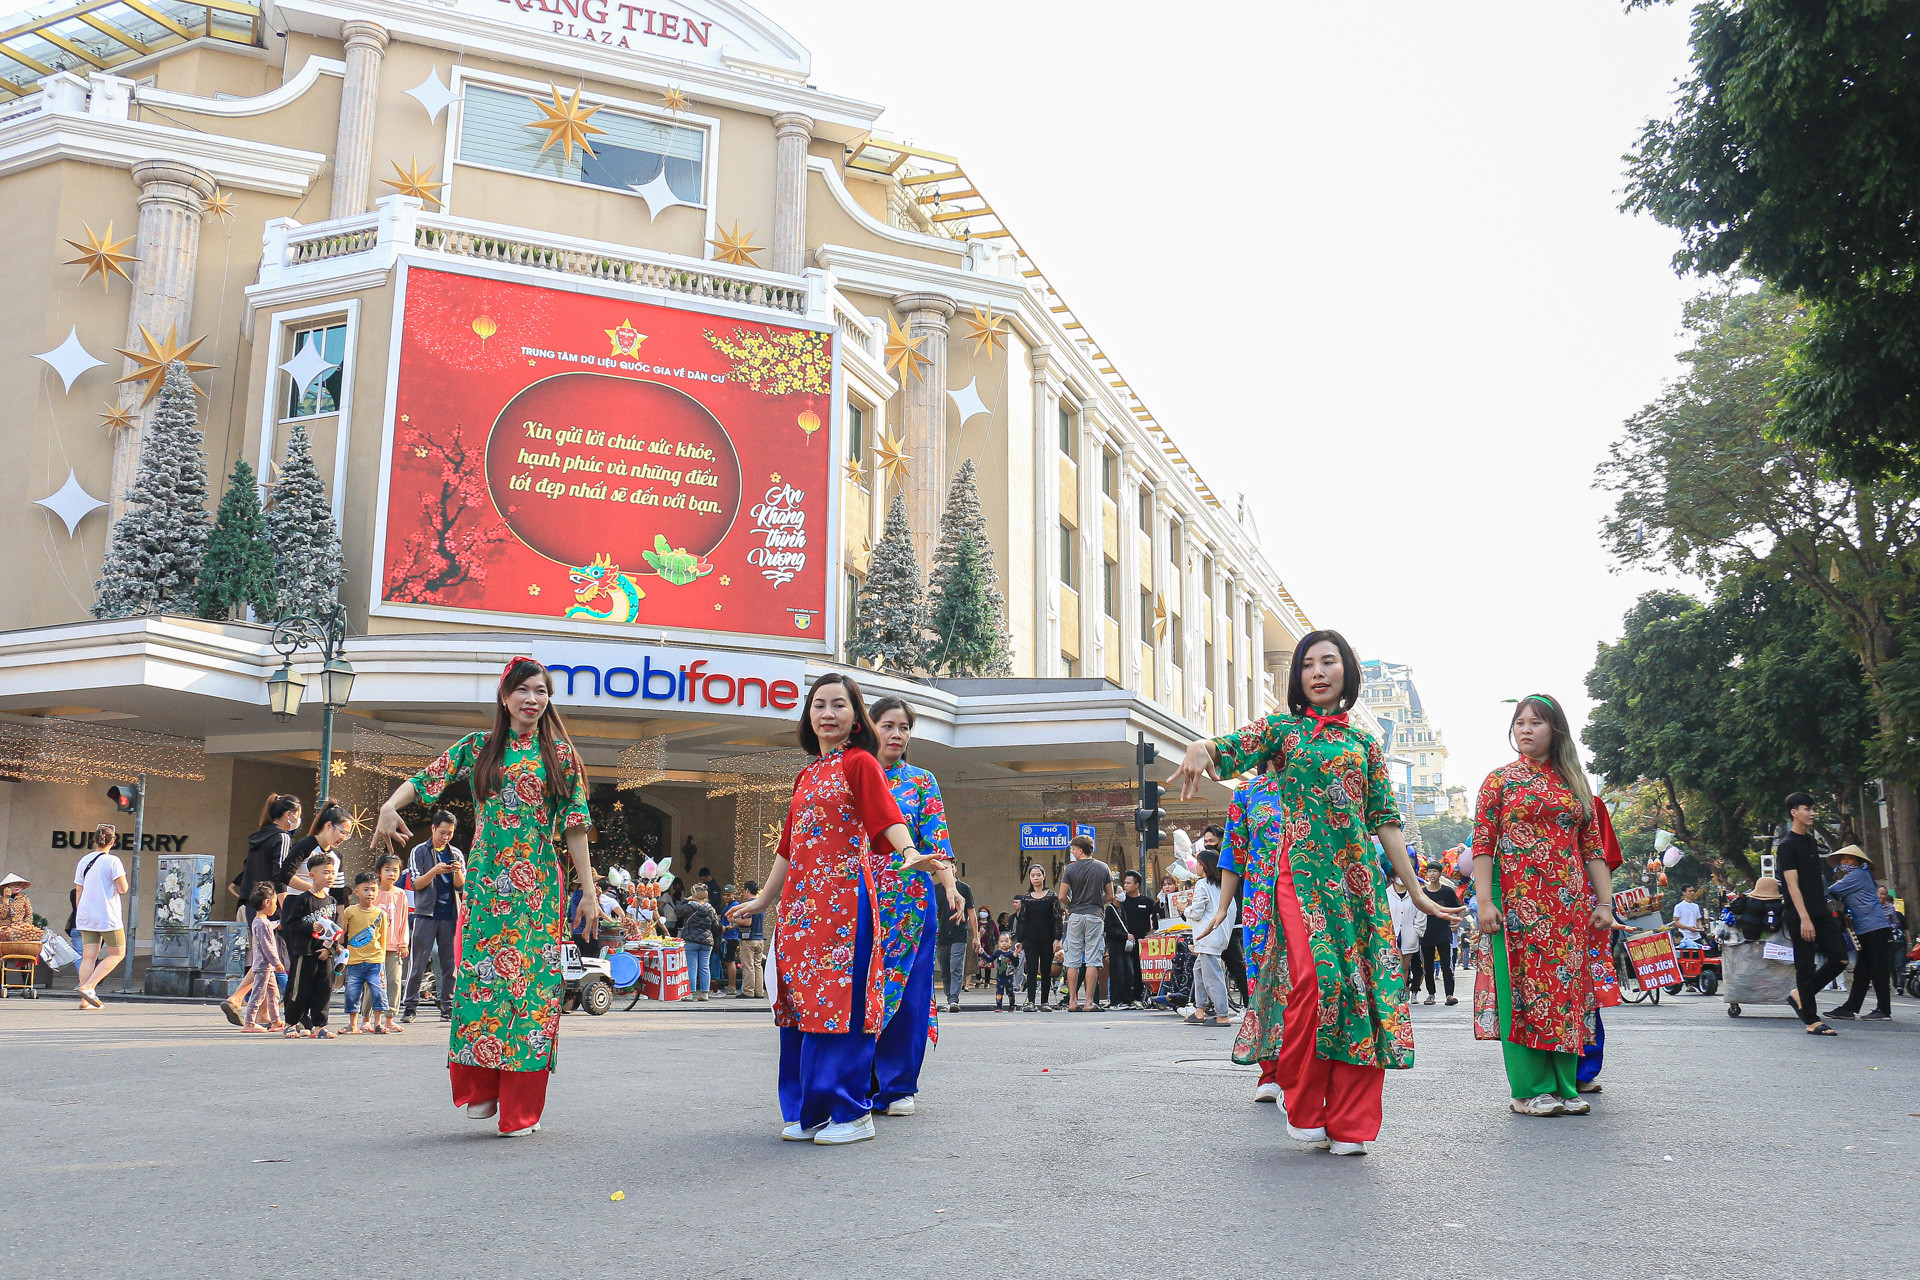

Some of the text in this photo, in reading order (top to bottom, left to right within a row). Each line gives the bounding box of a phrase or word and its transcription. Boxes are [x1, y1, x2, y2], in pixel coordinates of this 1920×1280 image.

[552, 20, 630, 48] PLAZA
[618, 3, 712, 47] TIEN
[521, 346, 726, 384] TRUNG TÂM DỮ LIỆU QUỐC GIA VỀ DÂN CƯ
[522, 420, 717, 464] Xin gửi lời chúc sức khỏe,
[517, 447, 719, 488] hạnh phúc và những điều
[509, 471, 723, 516] tốt đẹp nhất sẽ đến với bạn.
[765, 483, 805, 508] An
[750, 503, 806, 530] Khang
[750, 528, 807, 551] thịnh
[746, 547, 806, 572] Vượng
[545, 655, 798, 709] mobifone
[1024, 833, 1067, 846] TRÀNG TIỀN
[1637, 960, 1674, 976] XÚC XÍCH
[1645, 973, 1675, 988] BÒ BÍA
